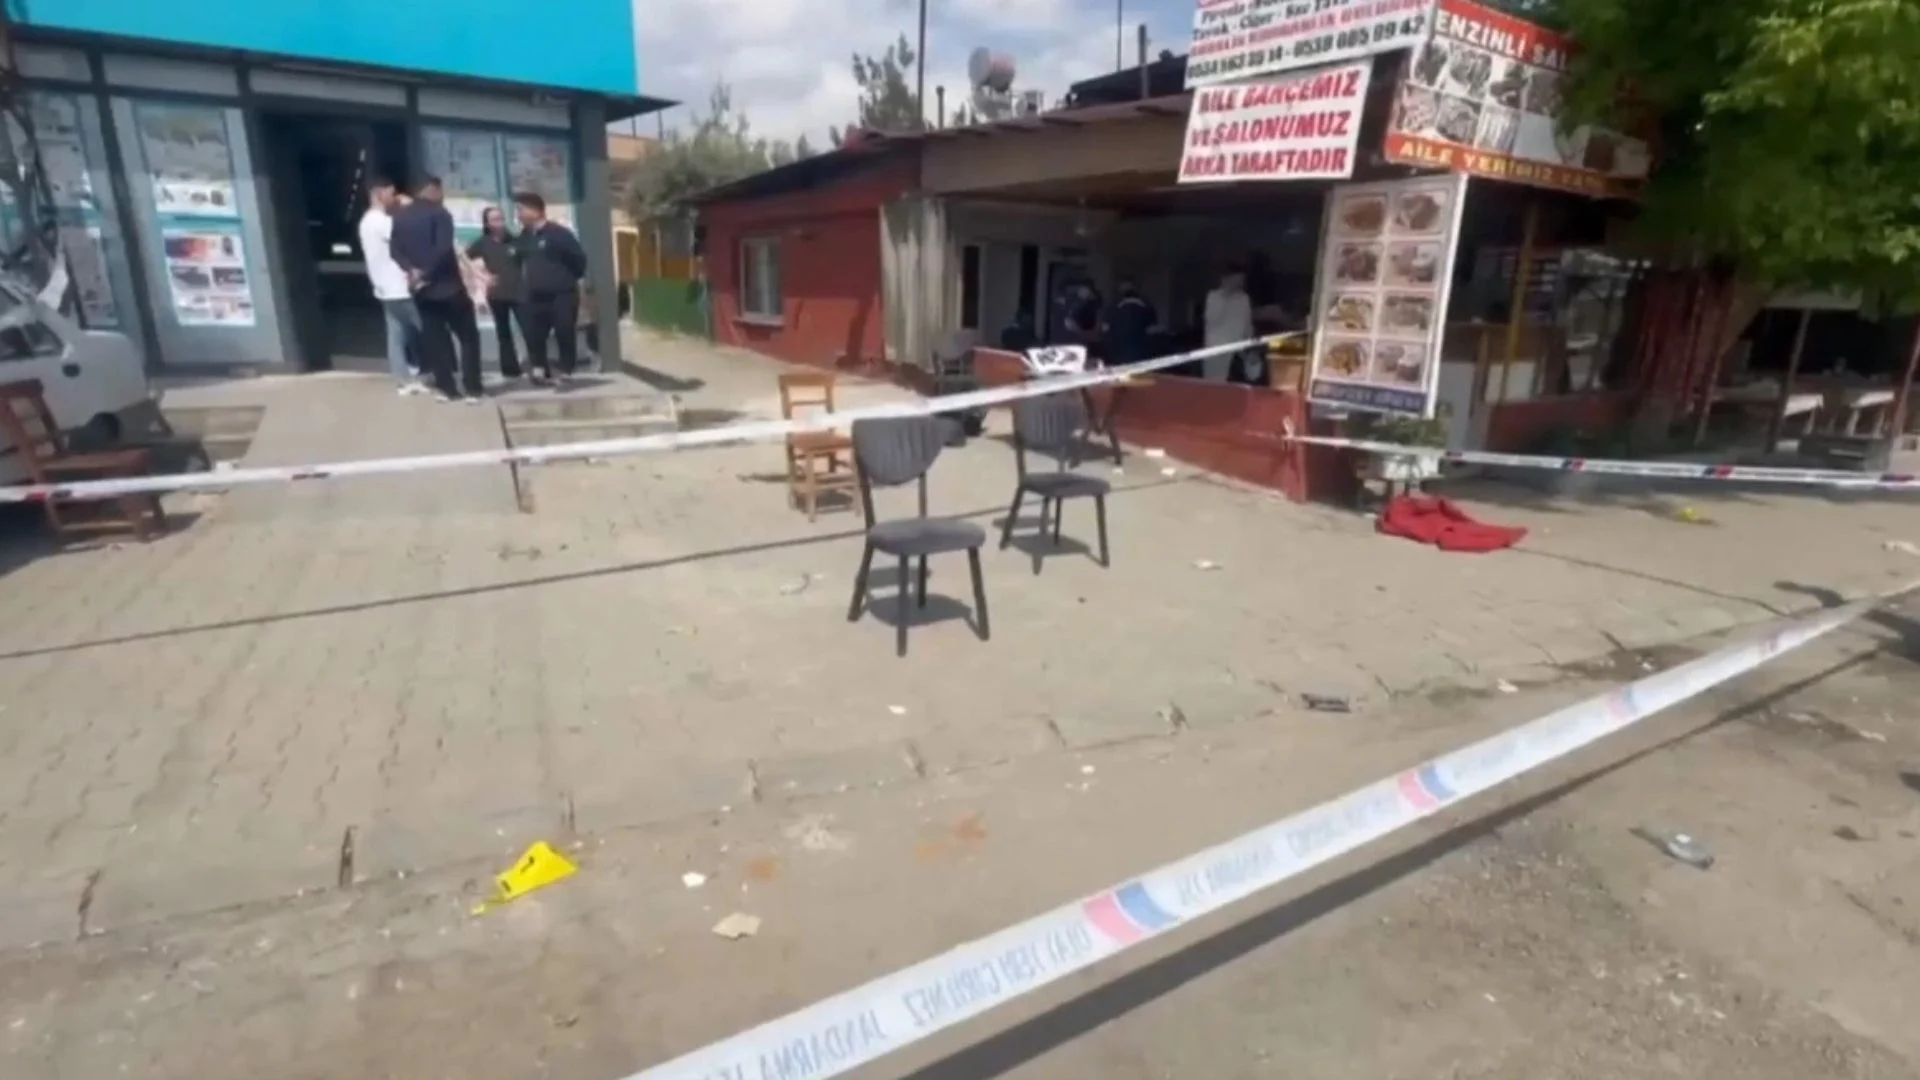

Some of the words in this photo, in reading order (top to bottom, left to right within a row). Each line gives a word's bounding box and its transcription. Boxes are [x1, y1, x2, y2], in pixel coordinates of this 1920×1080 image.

[1435, 9, 1529, 59] ENZİNLİ
[1213, 111, 1351, 145] SALONUMUZ
[1184, 153, 1226, 176] ARKA
[1232, 148, 1348, 175] TARAFTADIR
[1400, 140, 1453, 164] AİLE
